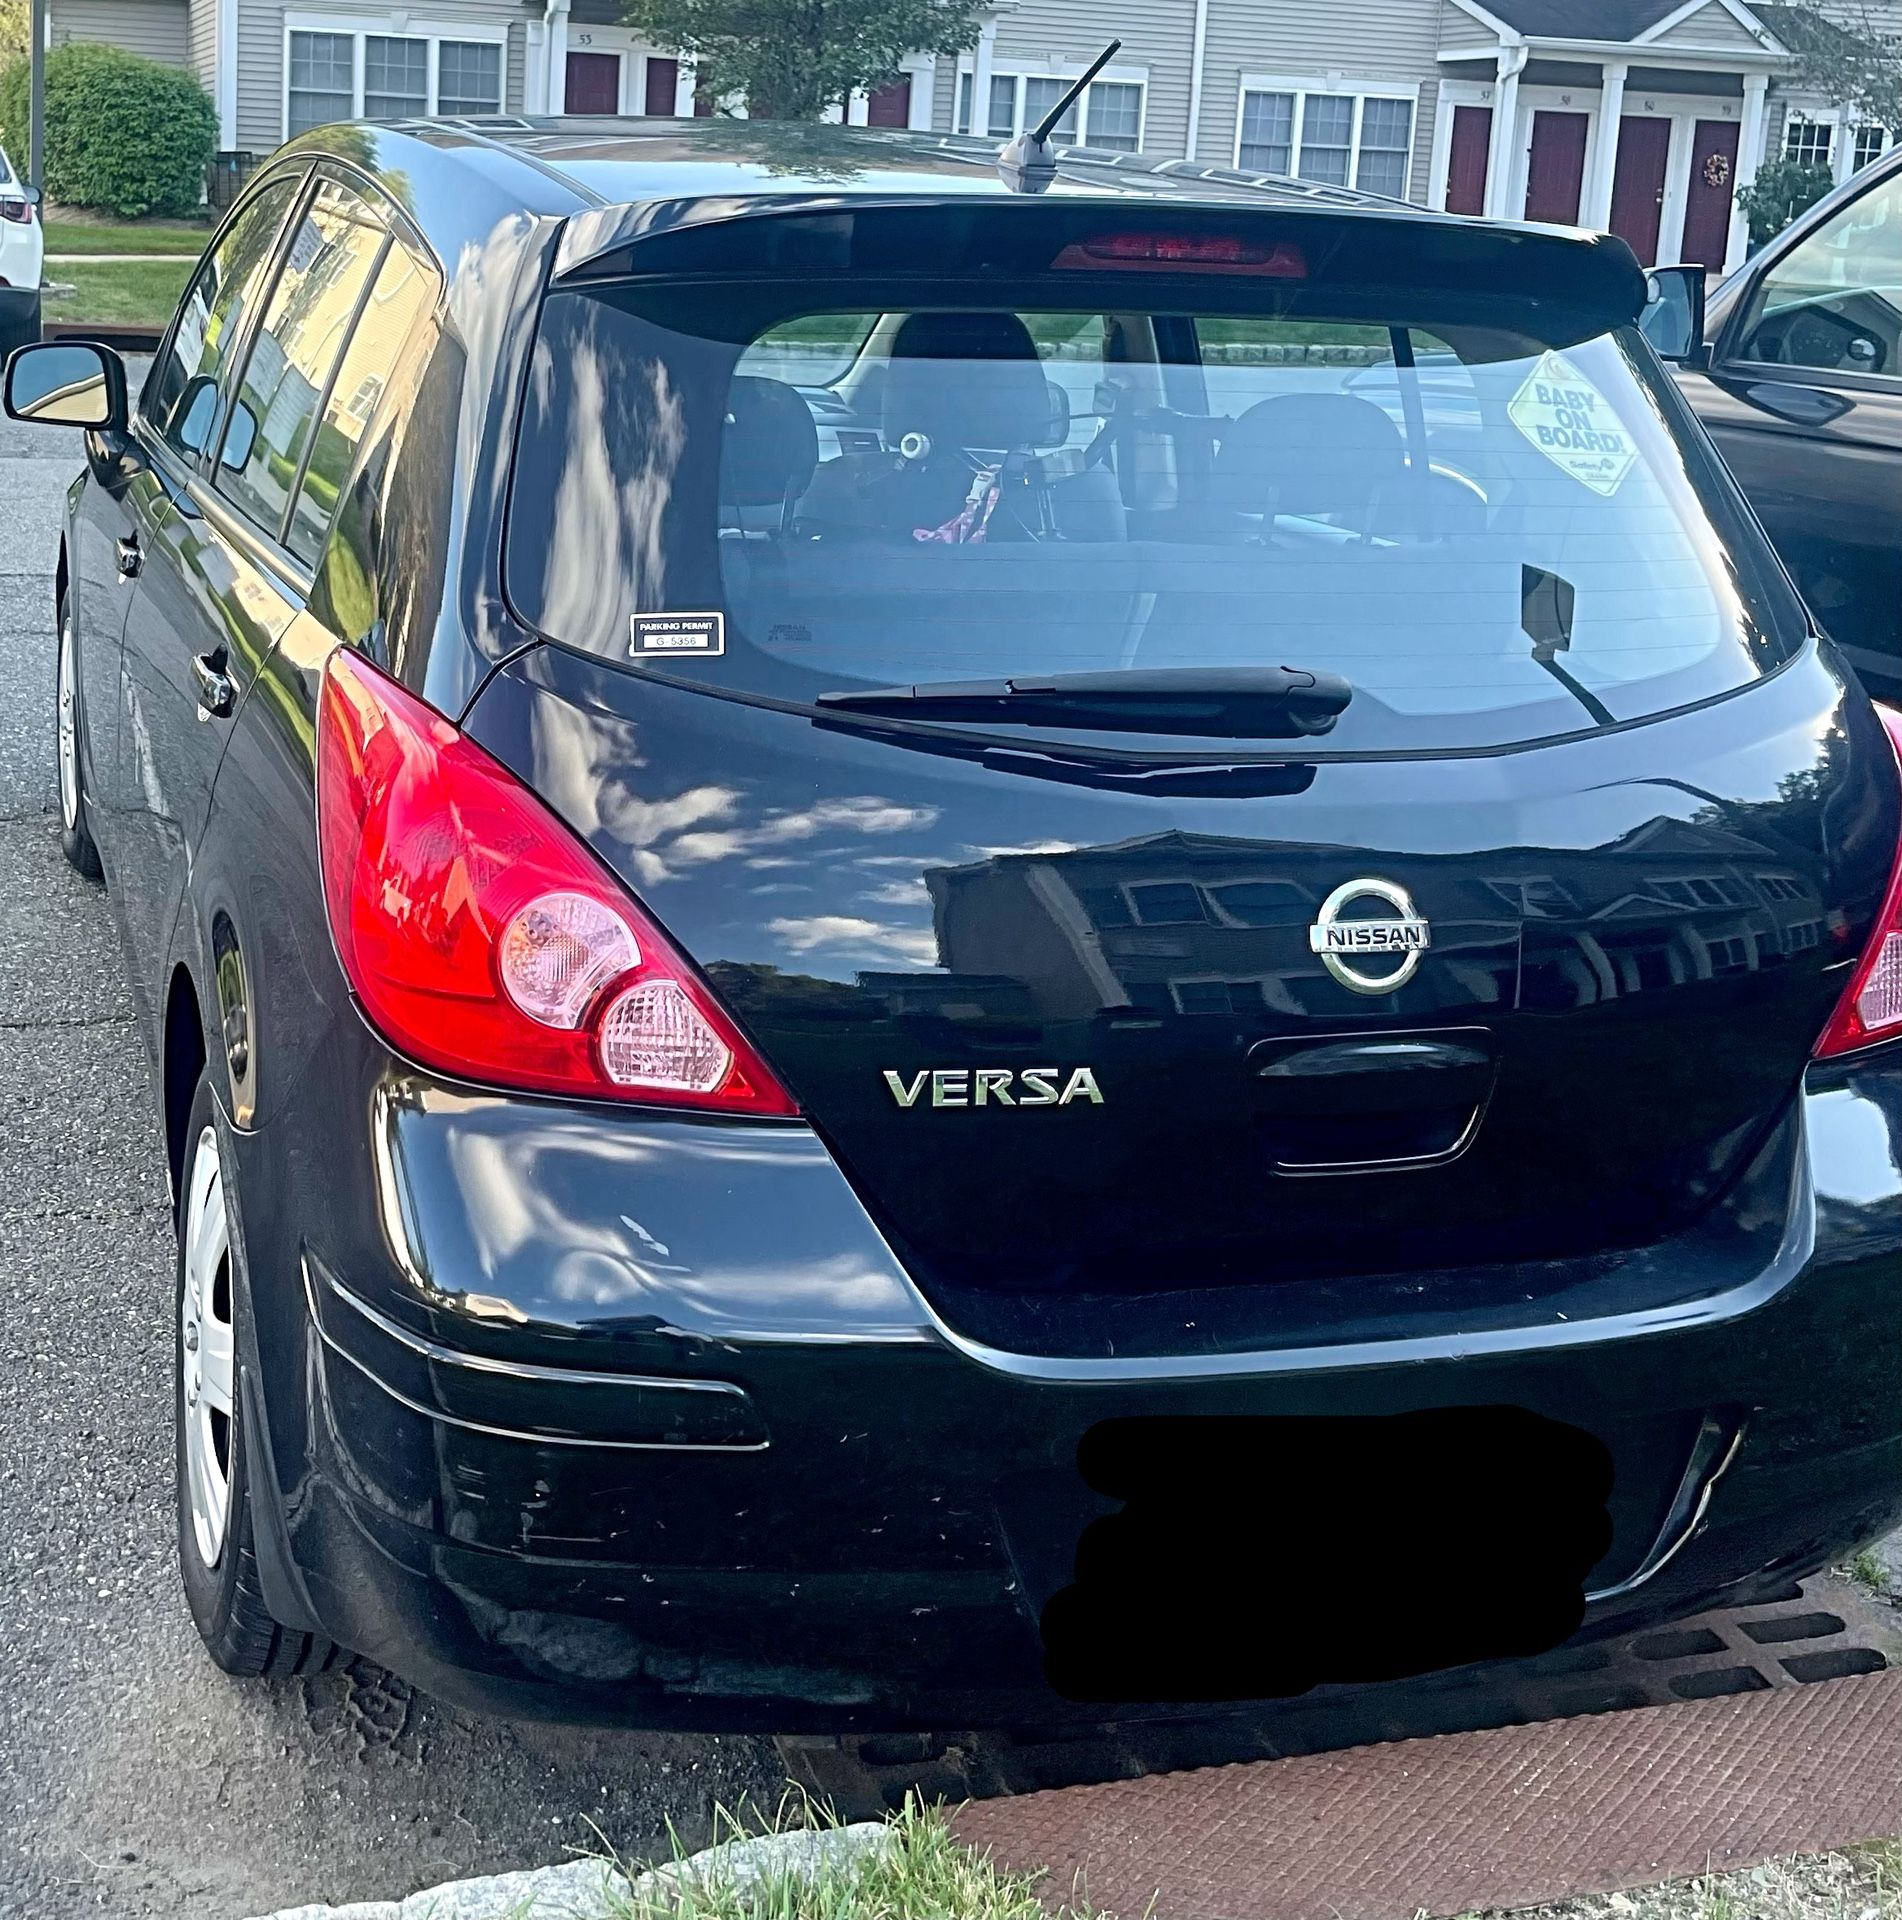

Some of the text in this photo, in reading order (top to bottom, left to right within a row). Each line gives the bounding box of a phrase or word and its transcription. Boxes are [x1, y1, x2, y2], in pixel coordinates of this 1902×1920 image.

[1535, 383, 1595, 412] BABY
[1555, 408, 1593, 431] ON
[1536, 424, 1627, 454] BOARD!
[639, 622, 713, 631] PARKING PERMIT
[1327, 926, 1421, 946] NISSAN
[883, 1067, 1104, 1107] VERSA
